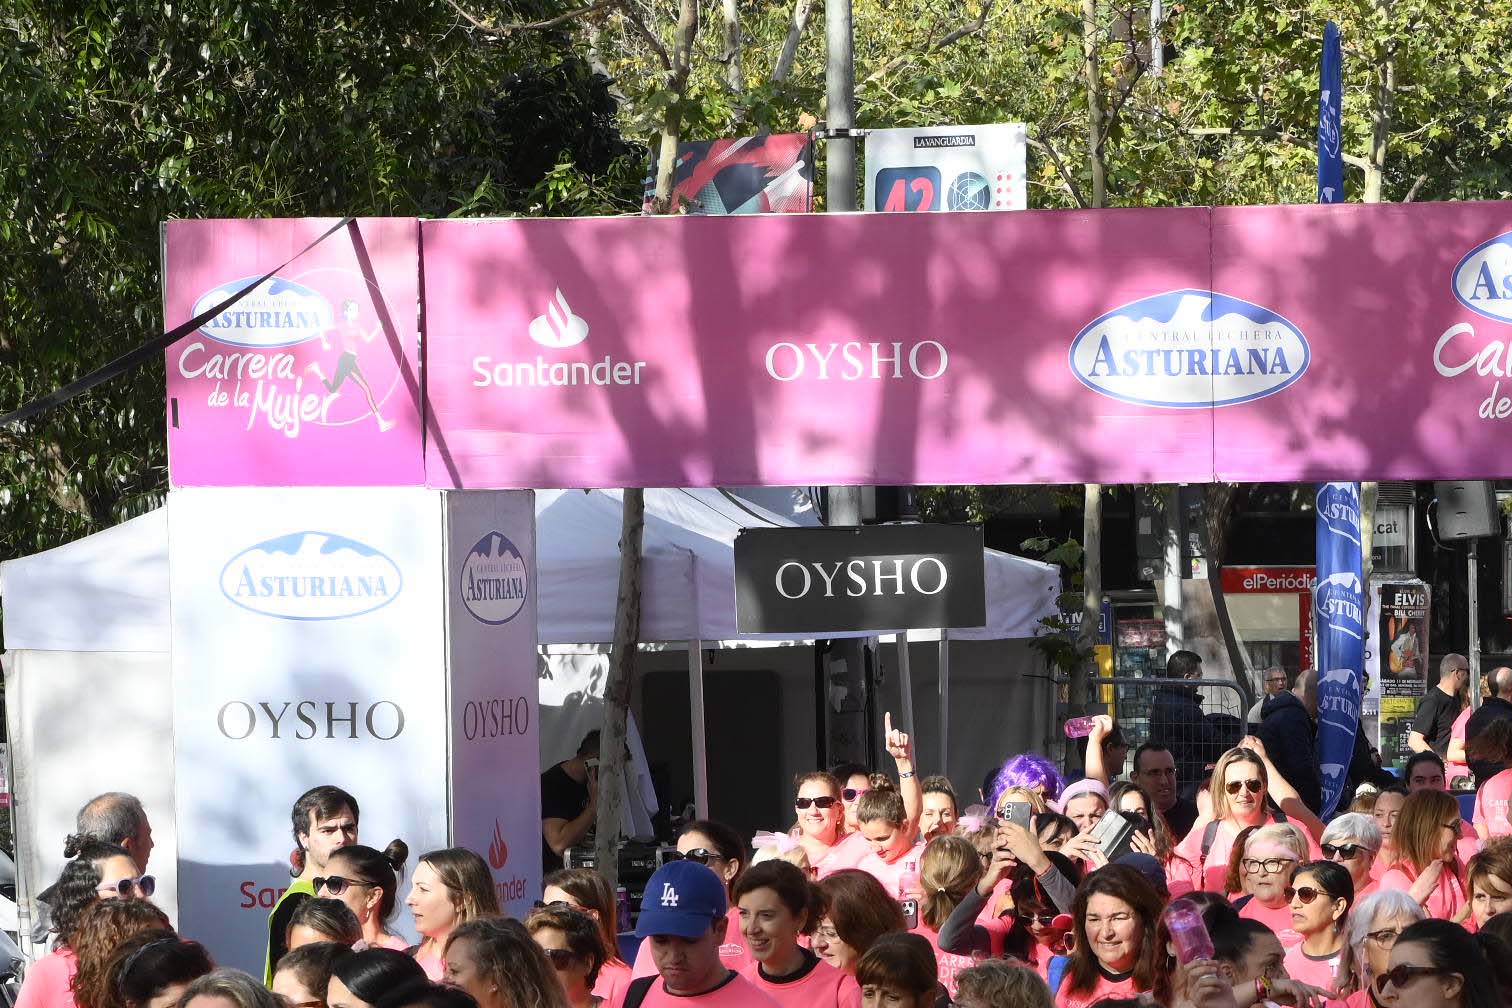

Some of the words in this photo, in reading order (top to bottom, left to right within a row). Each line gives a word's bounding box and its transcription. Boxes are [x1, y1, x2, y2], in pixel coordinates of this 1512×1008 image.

[179, 342, 296, 379] Carrera
[473, 356, 646, 387] Santander
[765, 341, 949, 381] OYSHO
[1088, 334, 1291, 377] ASTURIANA
[207, 381, 229, 408] de
[233, 384, 248, 408] la
[247, 373, 341, 438] Mujer
[235, 565, 391, 598] ASTURIANA
[466, 575, 524, 603] ASTURIANA
[775, 557, 948, 599] OYSHO
[1394, 593, 1425, 606] ELVIS
[217, 700, 405, 740] OYSHO
[463, 696, 530, 740] OYSHO
